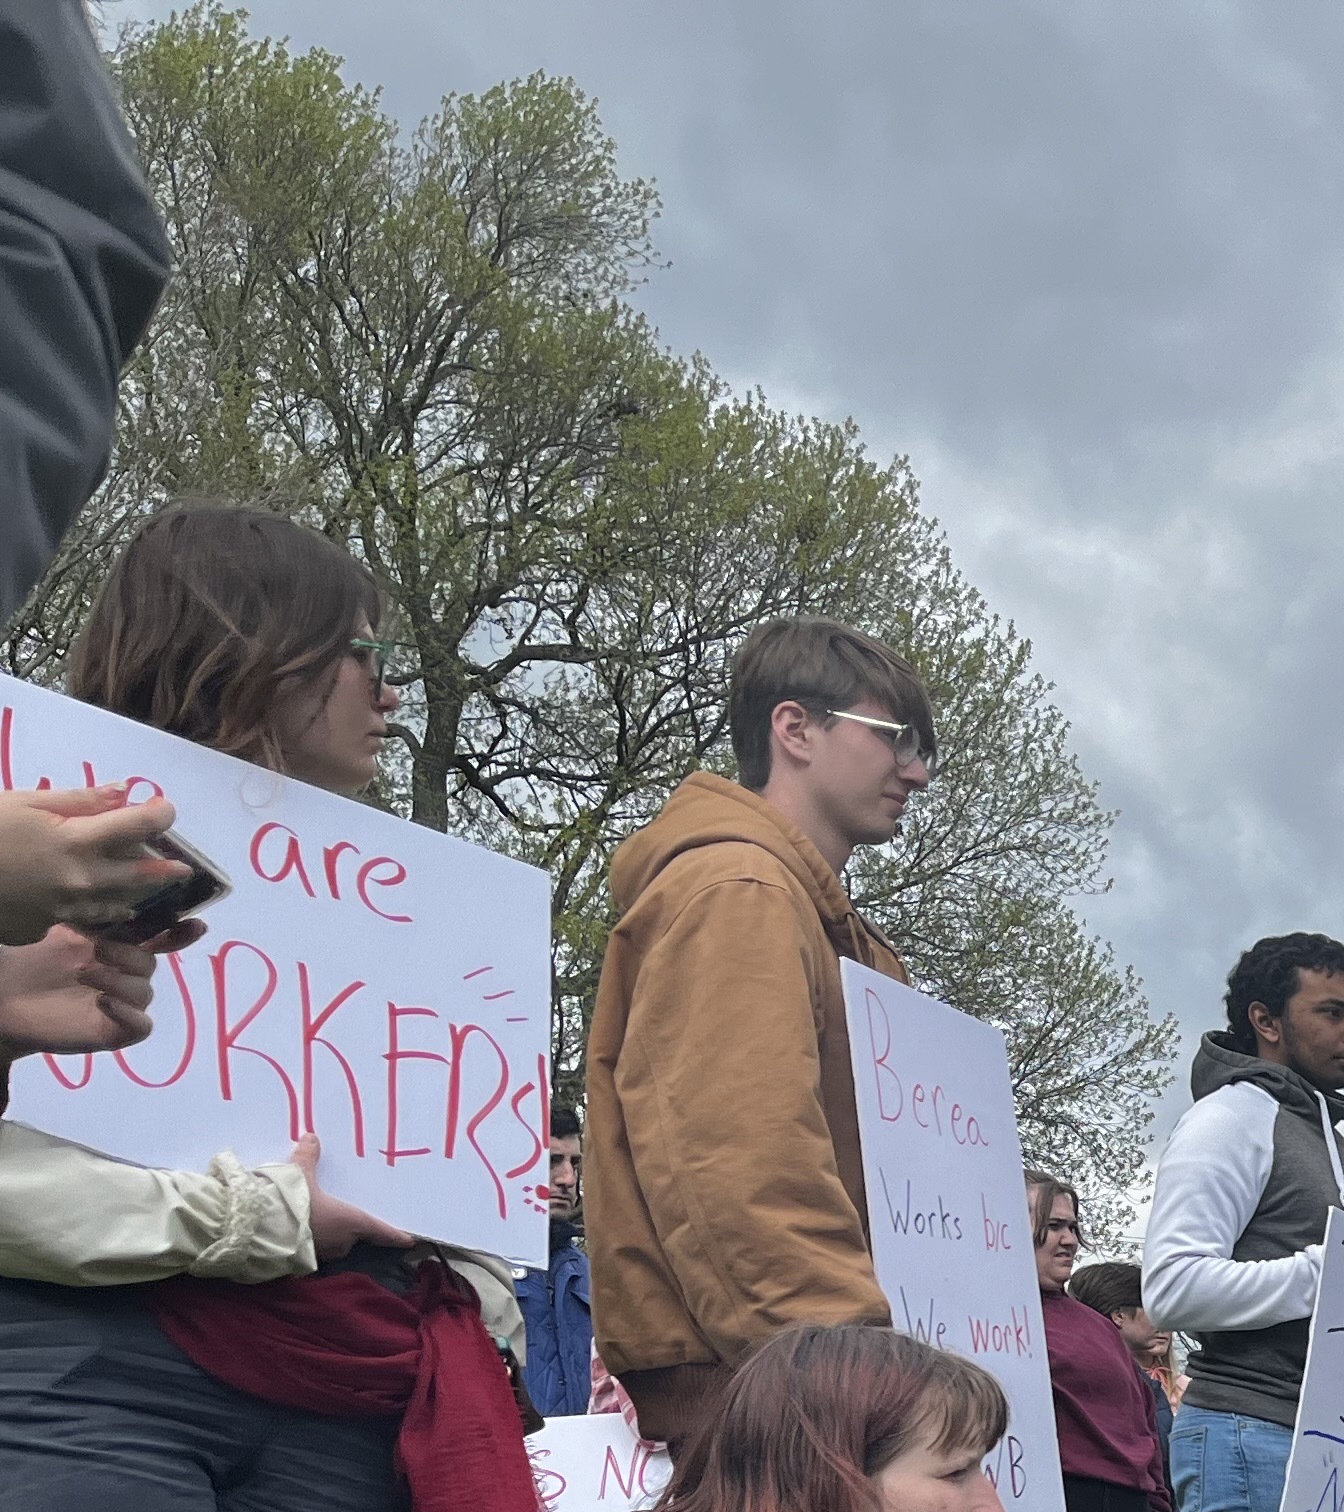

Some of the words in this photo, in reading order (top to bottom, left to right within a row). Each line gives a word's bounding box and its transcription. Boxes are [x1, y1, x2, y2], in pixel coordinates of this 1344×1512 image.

[249, 822, 413, 922] are
[42, 940, 549, 1220] ORKERS!
[865, 987, 989, 1147] Berea
[879, 1166, 963, 1240] Works
[900, 1286, 947, 1347] We
